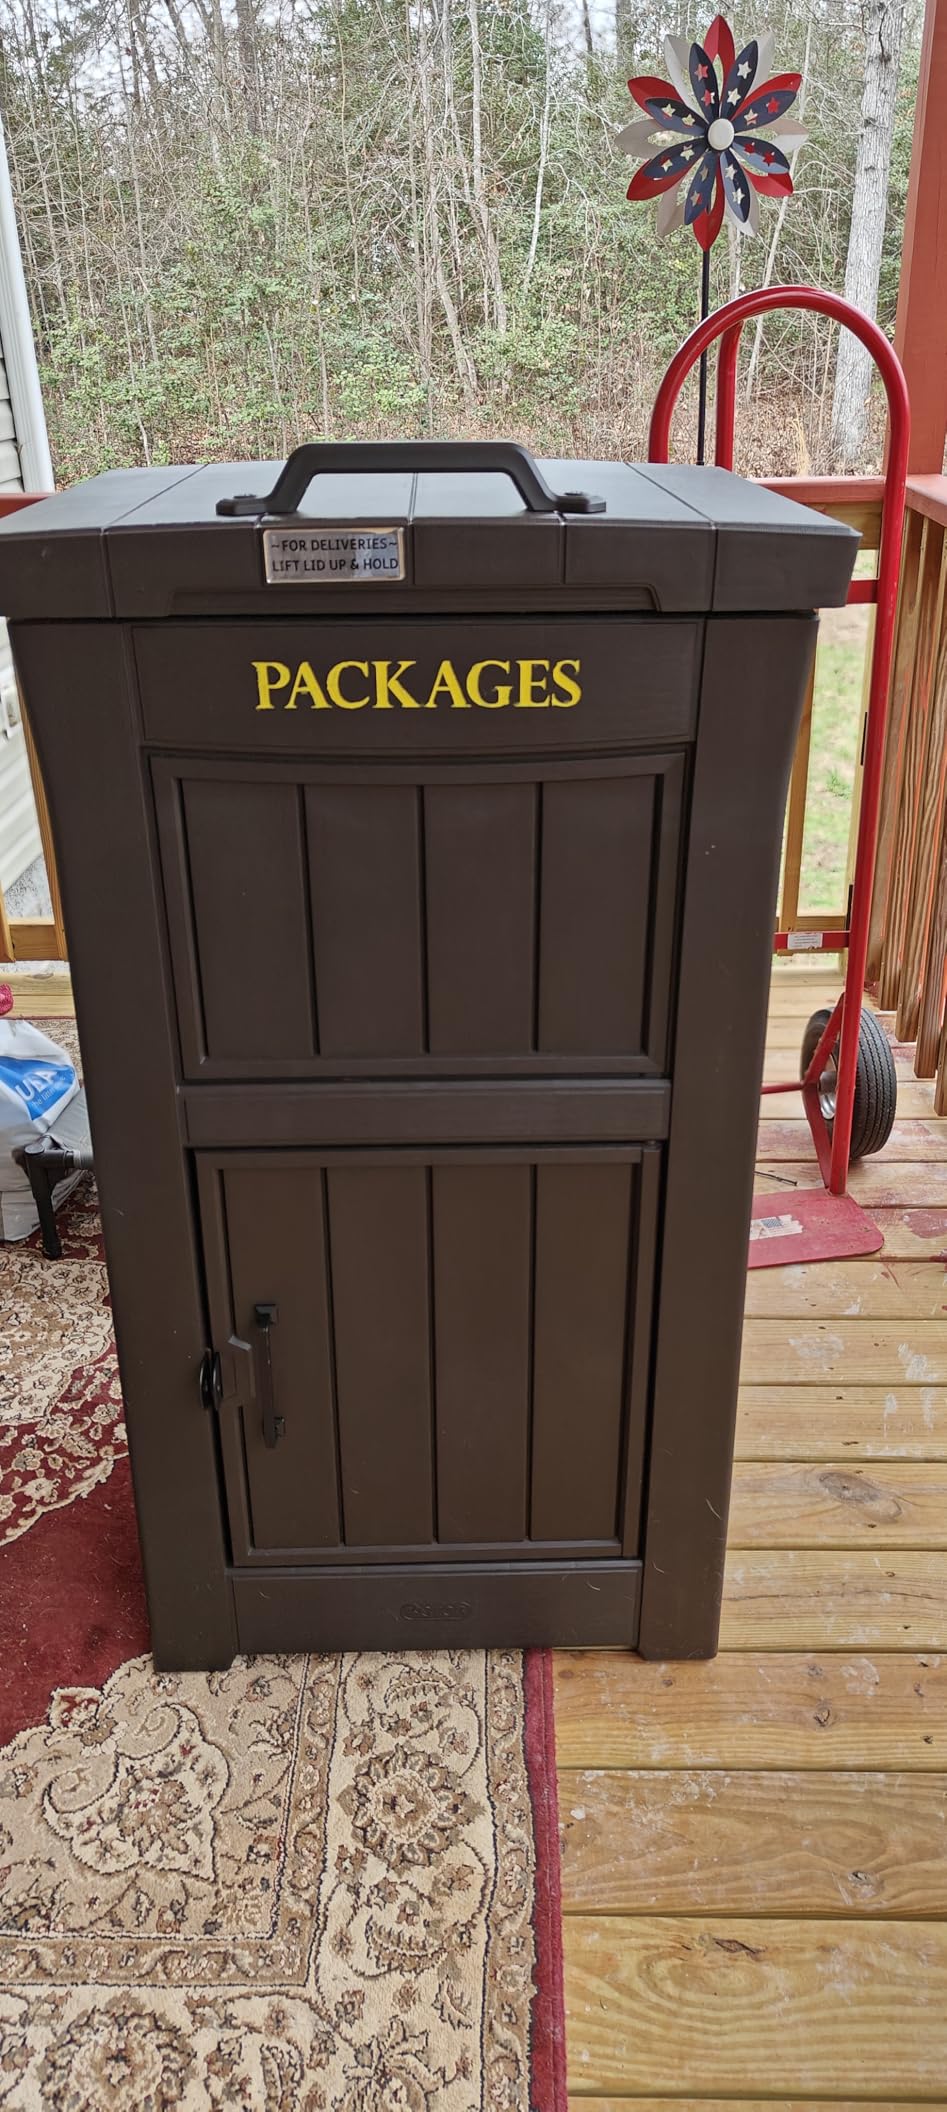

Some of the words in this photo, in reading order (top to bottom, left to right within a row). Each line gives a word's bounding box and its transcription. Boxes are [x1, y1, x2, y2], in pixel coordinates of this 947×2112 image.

[272, 560, 299, 572] LIFT
[304, 560, 326, 571] LID
[329, 559, 346, 571] UP
[350, 559, 359, 570] &
[363, 558, 398, 571] HOLD
[251, 660, 583, 711] PACKAGES
